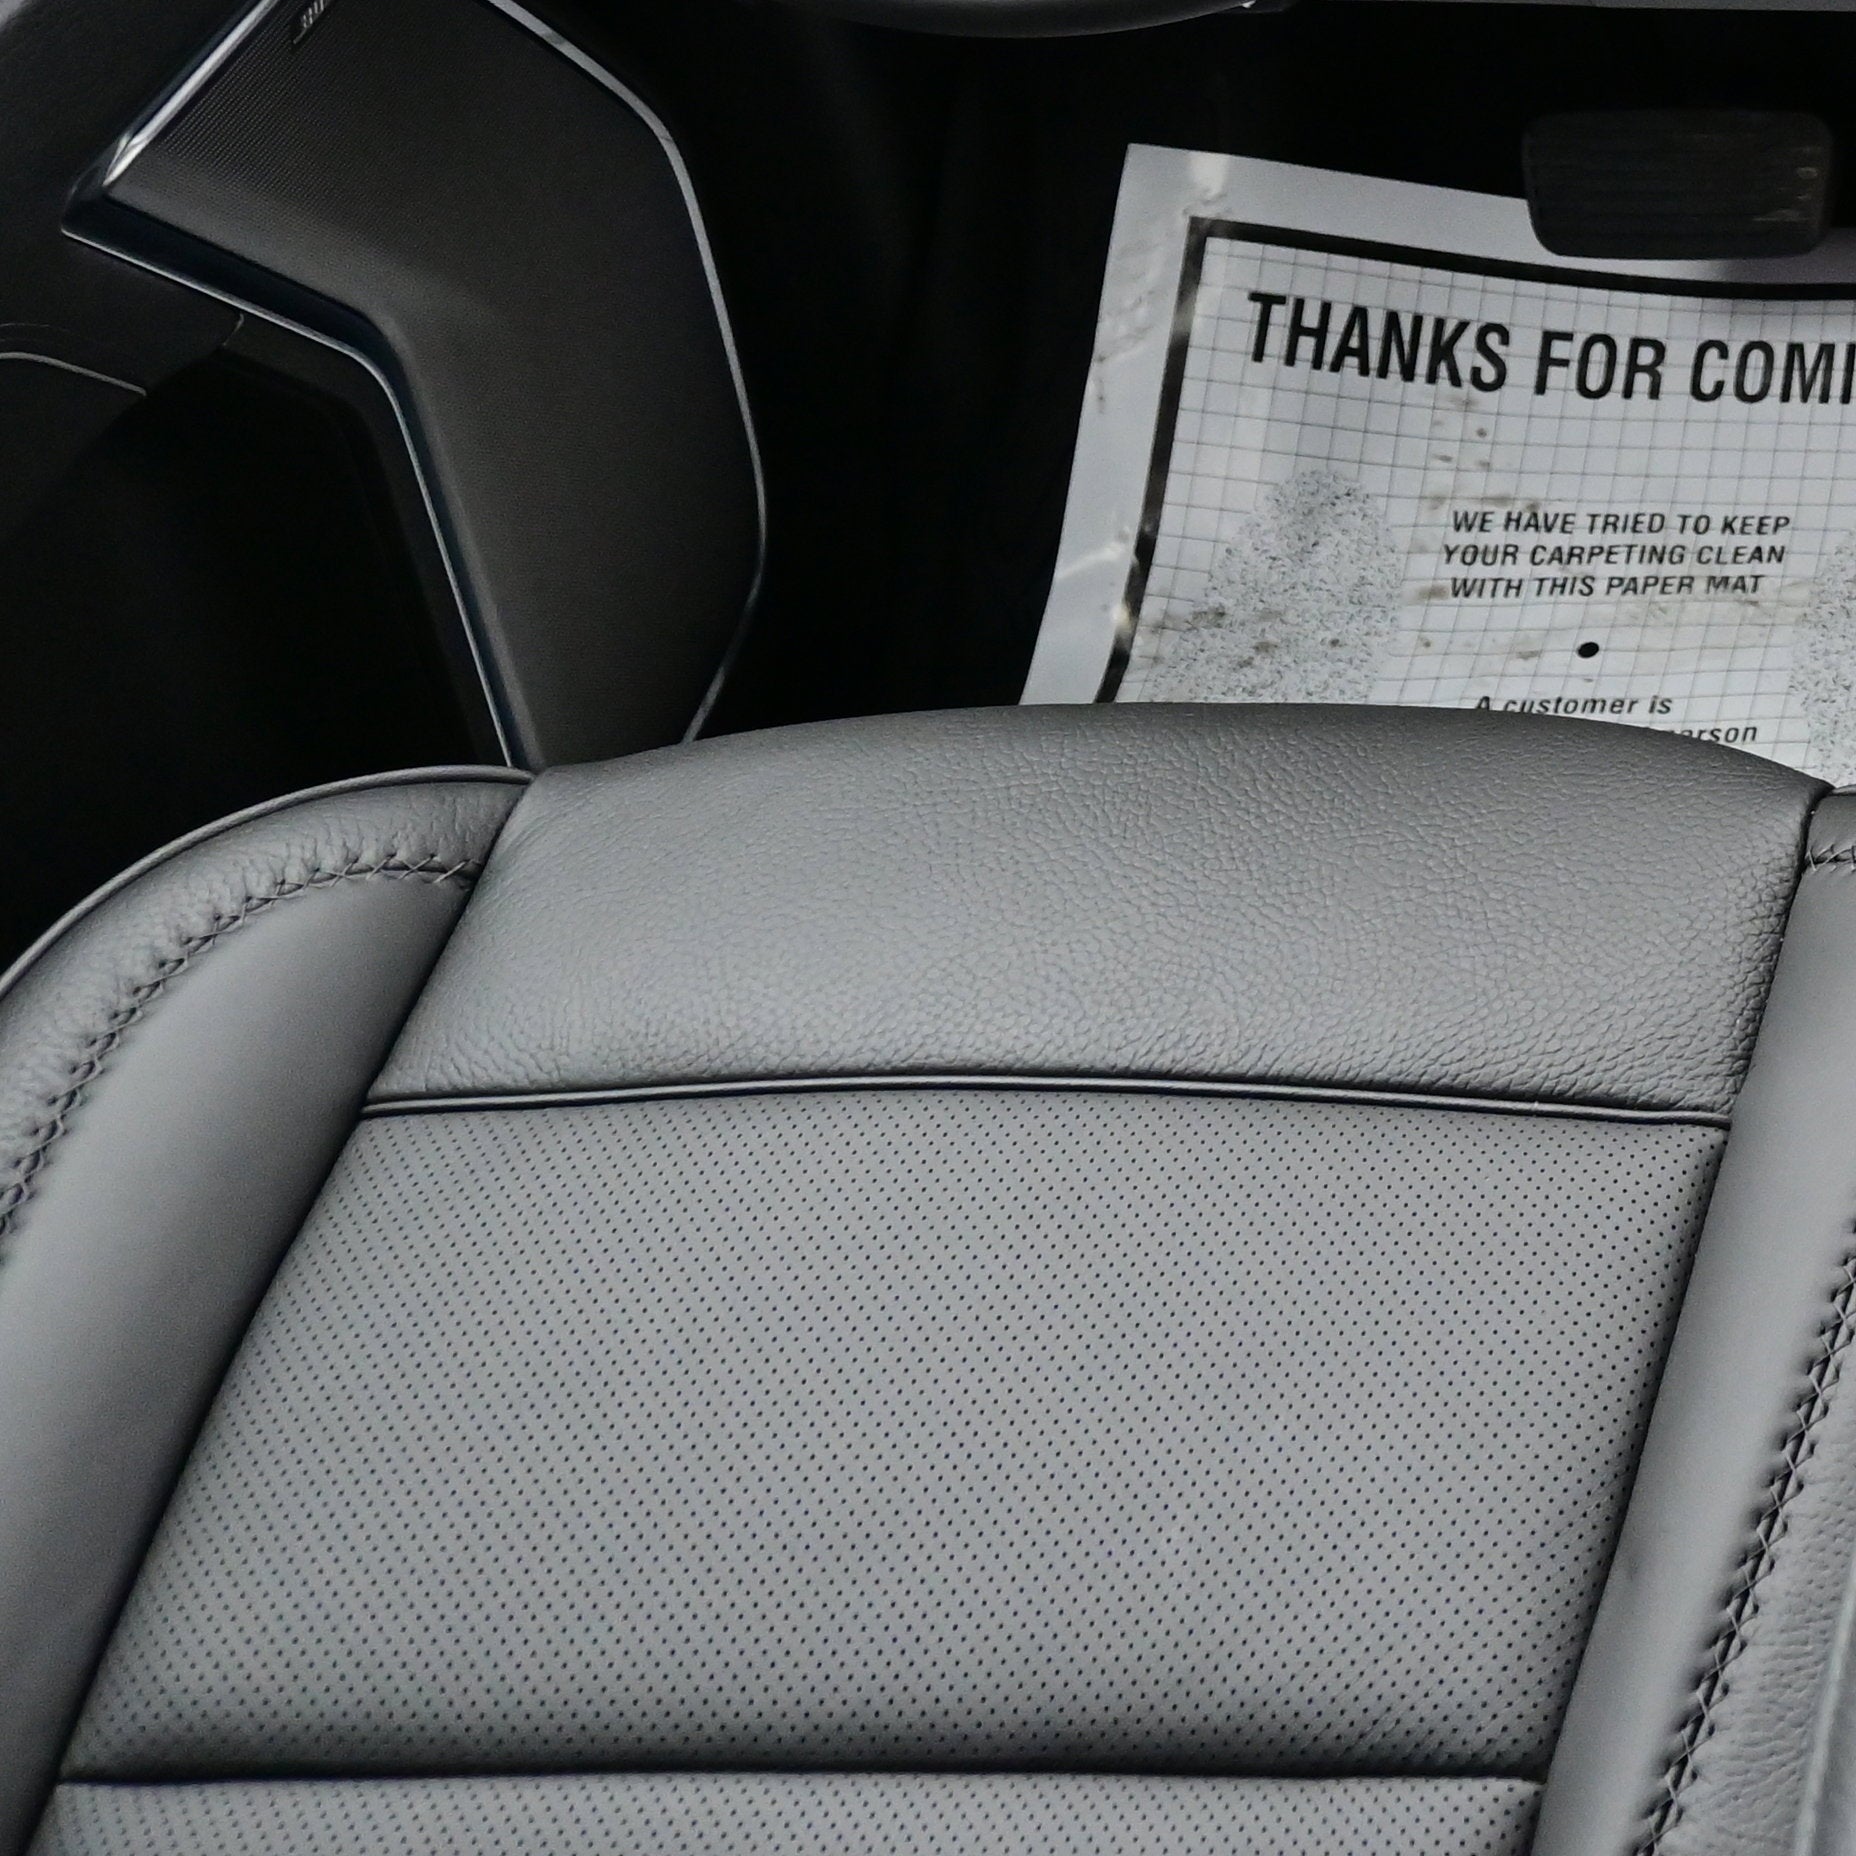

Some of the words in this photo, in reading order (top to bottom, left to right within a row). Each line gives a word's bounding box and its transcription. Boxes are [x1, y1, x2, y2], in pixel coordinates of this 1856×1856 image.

[1248, 291, 1510, 393] THANKS
[1534, 330, 1666, 401] FOR
[1452, 510, 1495, 533] WE
[1503, 511, 1576, 535] HAVE
[1586, 512, 1666, 535] TRIED
[1677, 513, 1711, 535] TO
[1720, 515, 1790, 536] KEEP
[1444, 544, 1520, 566] YOUR
[1530, 544, 1687, 566] CARPETING
[1696, 544, 1786, 565] CLEAN
[1451, 577, 1523, 599] WITH
[1534, 575, 1595, 598] THIS
[1606, 575, 1695, 595] PAPER
[1705, 574, 1765, 594] MAT
